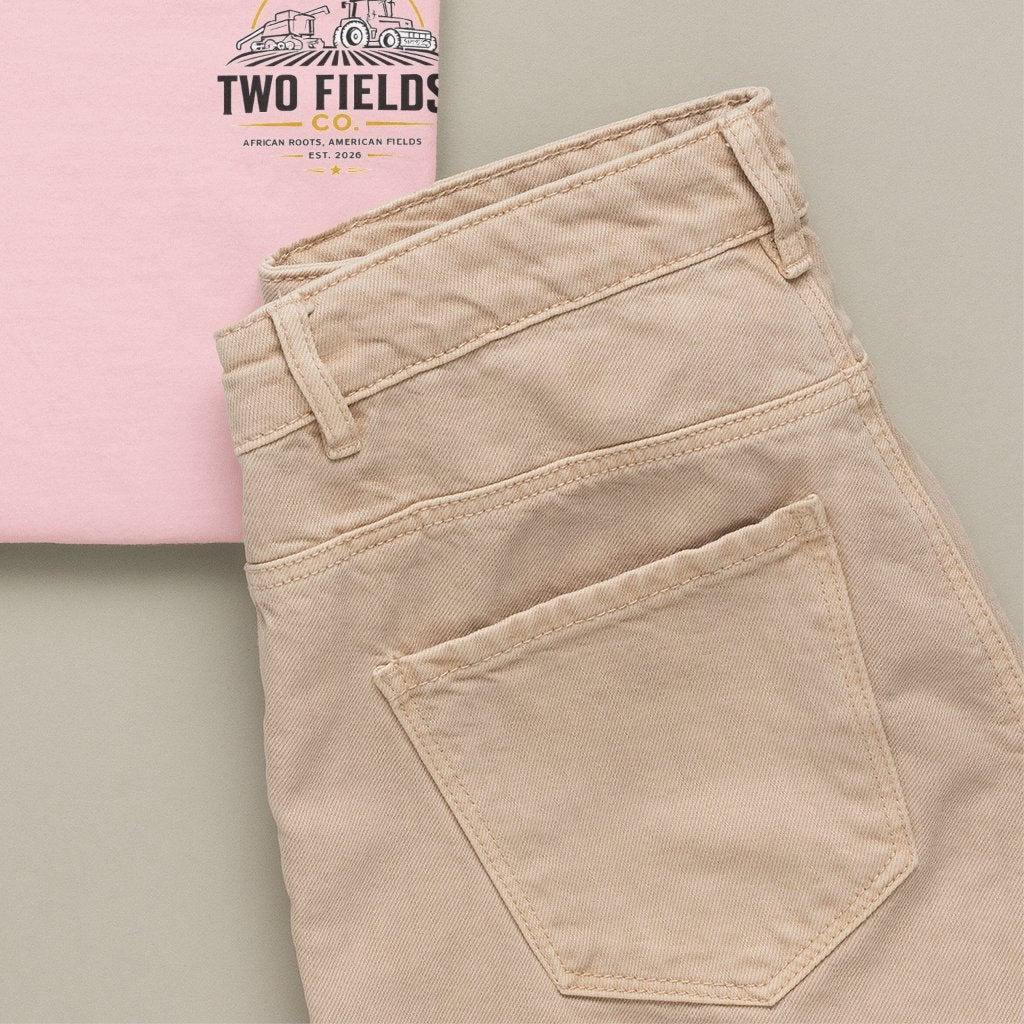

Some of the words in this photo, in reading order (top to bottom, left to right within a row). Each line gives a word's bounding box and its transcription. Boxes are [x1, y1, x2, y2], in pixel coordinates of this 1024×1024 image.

[216, 74, 298, 116] TWO
[311, 113, 359, 132] CO.
[242, 138, 285, 147] AFRICAN
[288, 138, 325, 147] ROOTS,
[328, 138, 383, 146] AMERICAN
[386, 137, 422, 146] FIELDS
[308, 151, 331, 160] EST.
[335, 151, 362, 159] 2026
